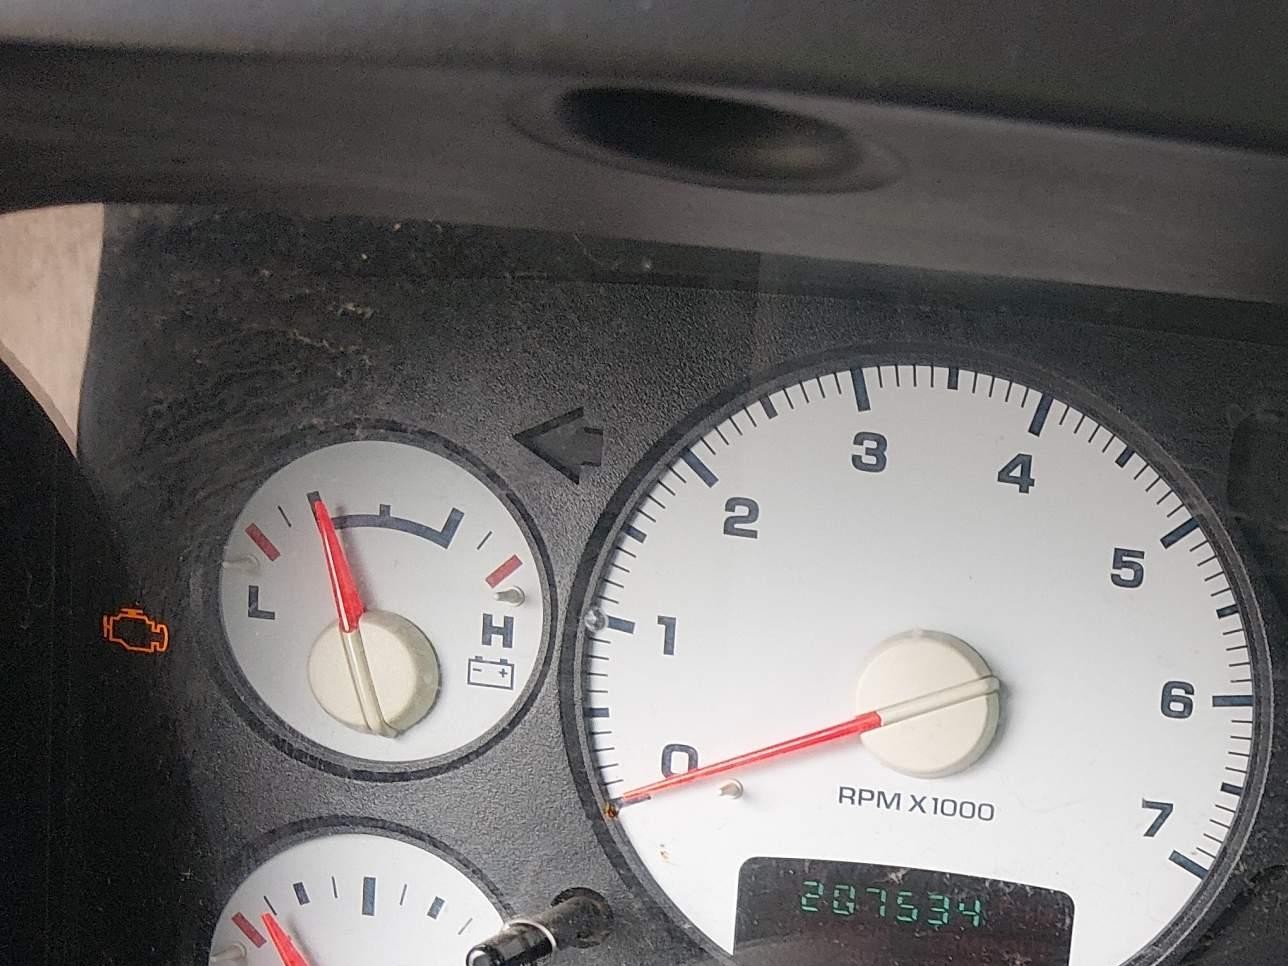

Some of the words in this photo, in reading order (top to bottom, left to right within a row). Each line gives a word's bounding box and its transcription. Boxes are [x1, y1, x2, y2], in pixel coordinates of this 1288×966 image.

[852, 432, 887, 472] 3
[997, 454, 1035, 493] 4
[723, 497, 759, 538] 2
[1111, 548, 1145, 588] 5
[248, 585, 275, 620] L
[482, 613, 514, 648] H
[658, 616, 676, 655] 1
[1161, 681, 1194, 719] 6
[661, 744, 699, 779] 0
[838, 786, 902, 811] RPM
[908, 794, 995, 822] X1000
[1142, 799, 1173, 837] 7
